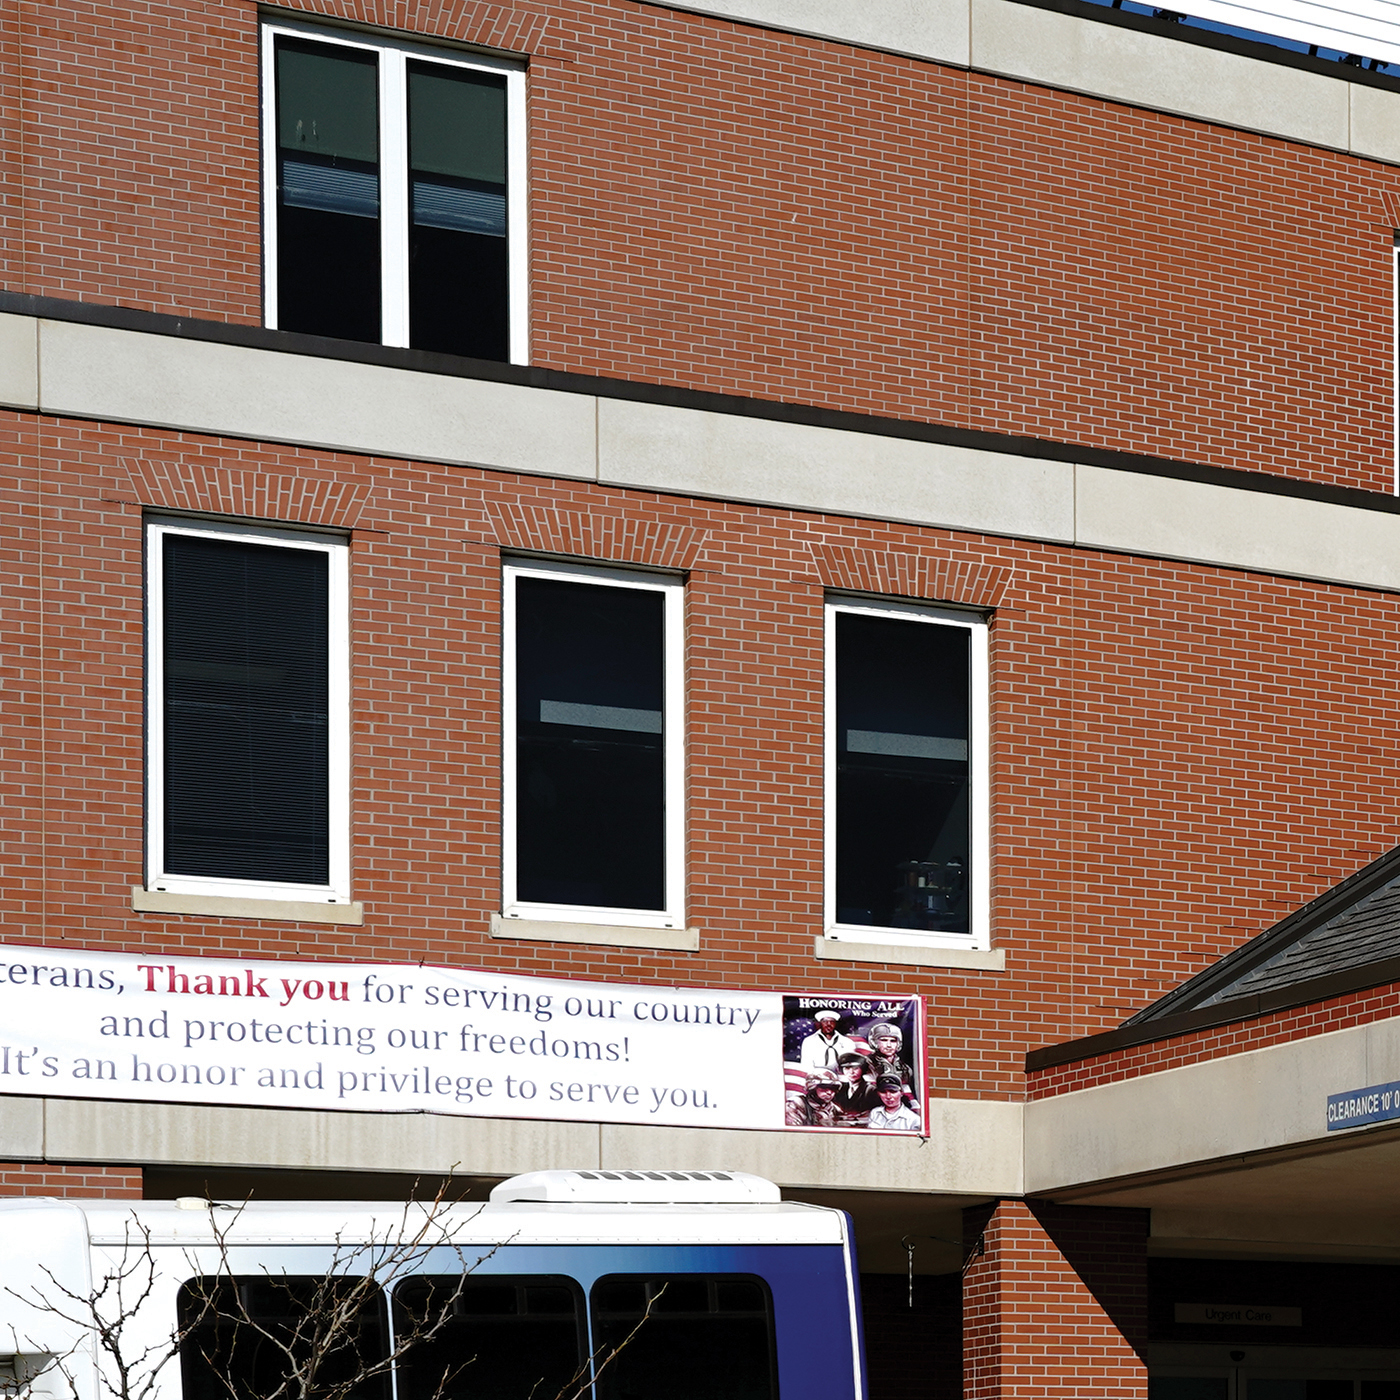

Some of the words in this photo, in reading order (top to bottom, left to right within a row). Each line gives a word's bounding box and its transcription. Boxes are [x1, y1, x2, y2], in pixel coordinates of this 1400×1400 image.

[137, 965, 270, 998] Thank
[279, 978, 350, 1007] you
[362, 975, 413, 1004] for
[424, 984, 553, 1022] serving
[564, 995, 622, 1019] our
[633, 1000, 761, 1034] country
[799, 998, 872, 1011] HONORING
[877, 1001, 905, 1011] ALL
[852, 1009, 871, 1018] Who
[871, 1010, 898, 1018] Served
[99, 1010, 170, 1039] and
[183, 1016, 376, 1055] protecting
[387, 1028, 448, 1050] our
[459, 1024, 630, 1062] freedoms!
[1, 1046, 60, 1077] It's
[71, 1057, 118, 1081] an
[130, 1053, 246, 1086] honor
[257, 1062, 325, 1090] and
[337, 1066, 493, 1104] privilege
[504, 1074, 537, 1100] to
[549, 1080, 640, 1104] serve
[650, 1086, 718, 1114] you.
[1328, 1094, 1379, 1122] CLEARANCE
[1205, 1308, 1241, 1322] Urgent
[1245, 1309, 1272, 1321] Care
